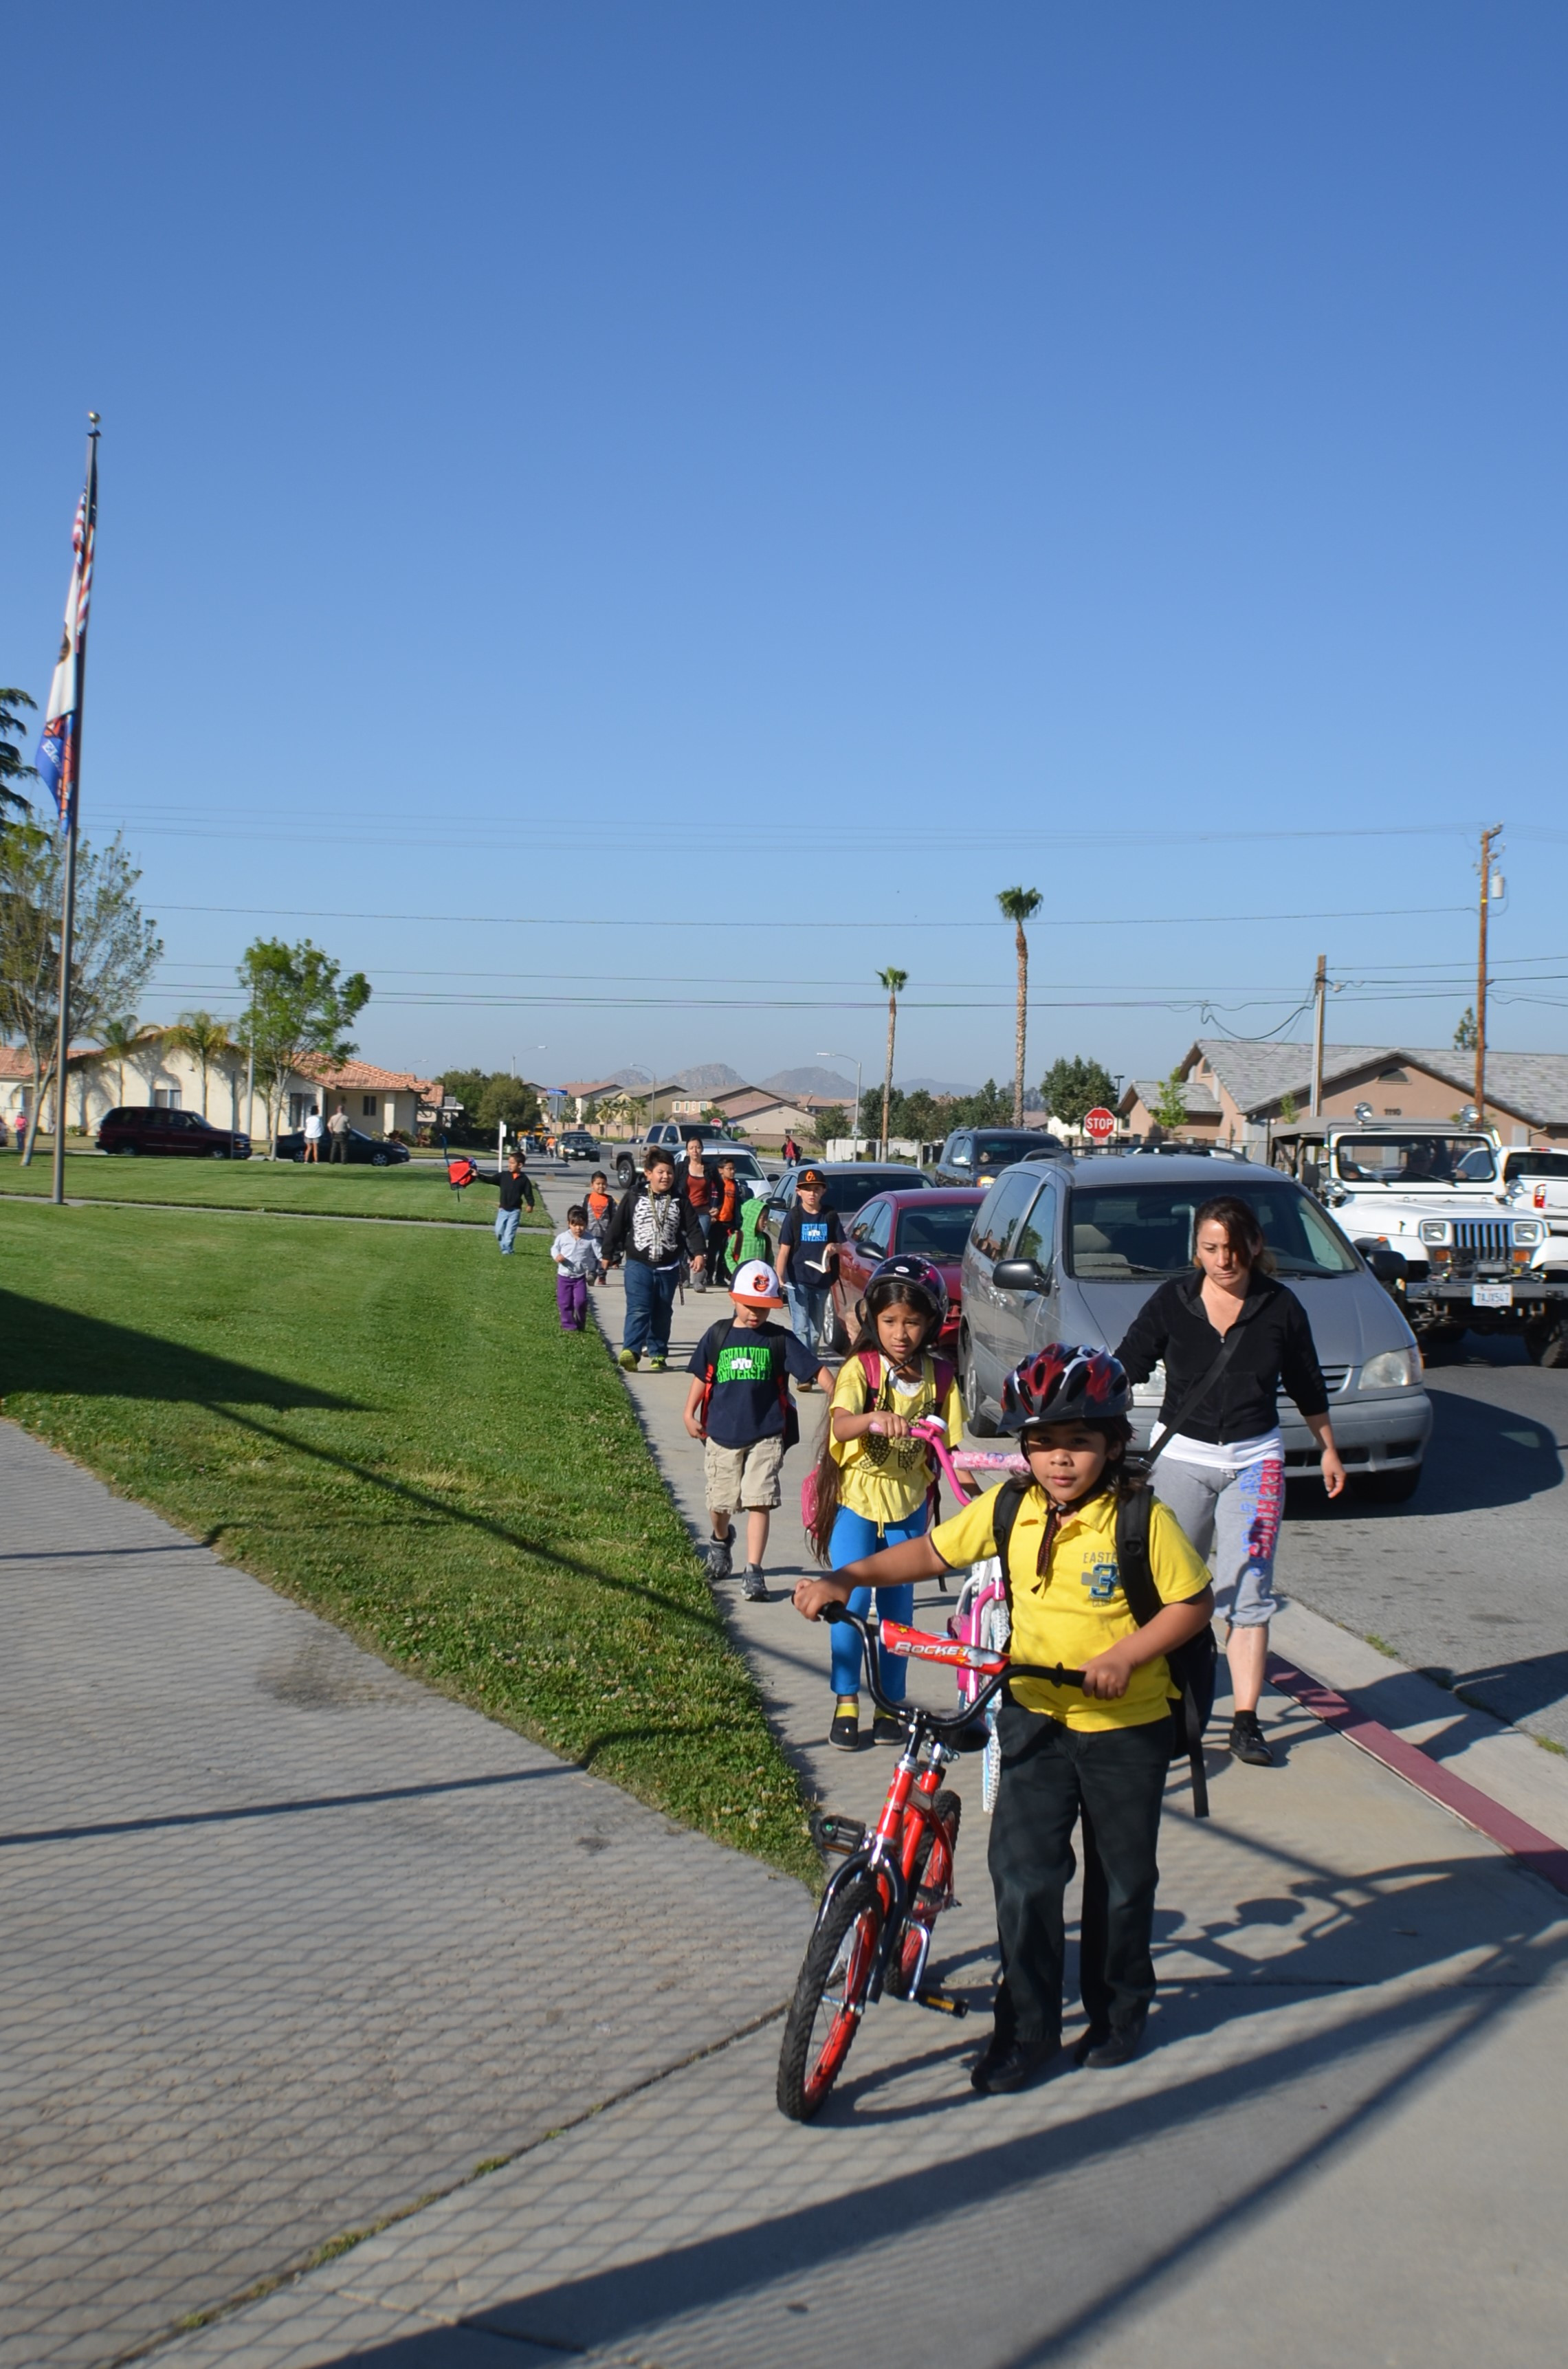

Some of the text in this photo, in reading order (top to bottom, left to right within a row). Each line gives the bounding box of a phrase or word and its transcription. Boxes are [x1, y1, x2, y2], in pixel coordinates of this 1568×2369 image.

[1086, 1117, 1113, 1130] STOP
[731, 1358, 752, 1370] BYU
[1249, 1499, 1281, 1559] HUGS
[1090, 1563, 1119, 1599] 3
[894, 1641, 970, 1657] ROCKET
